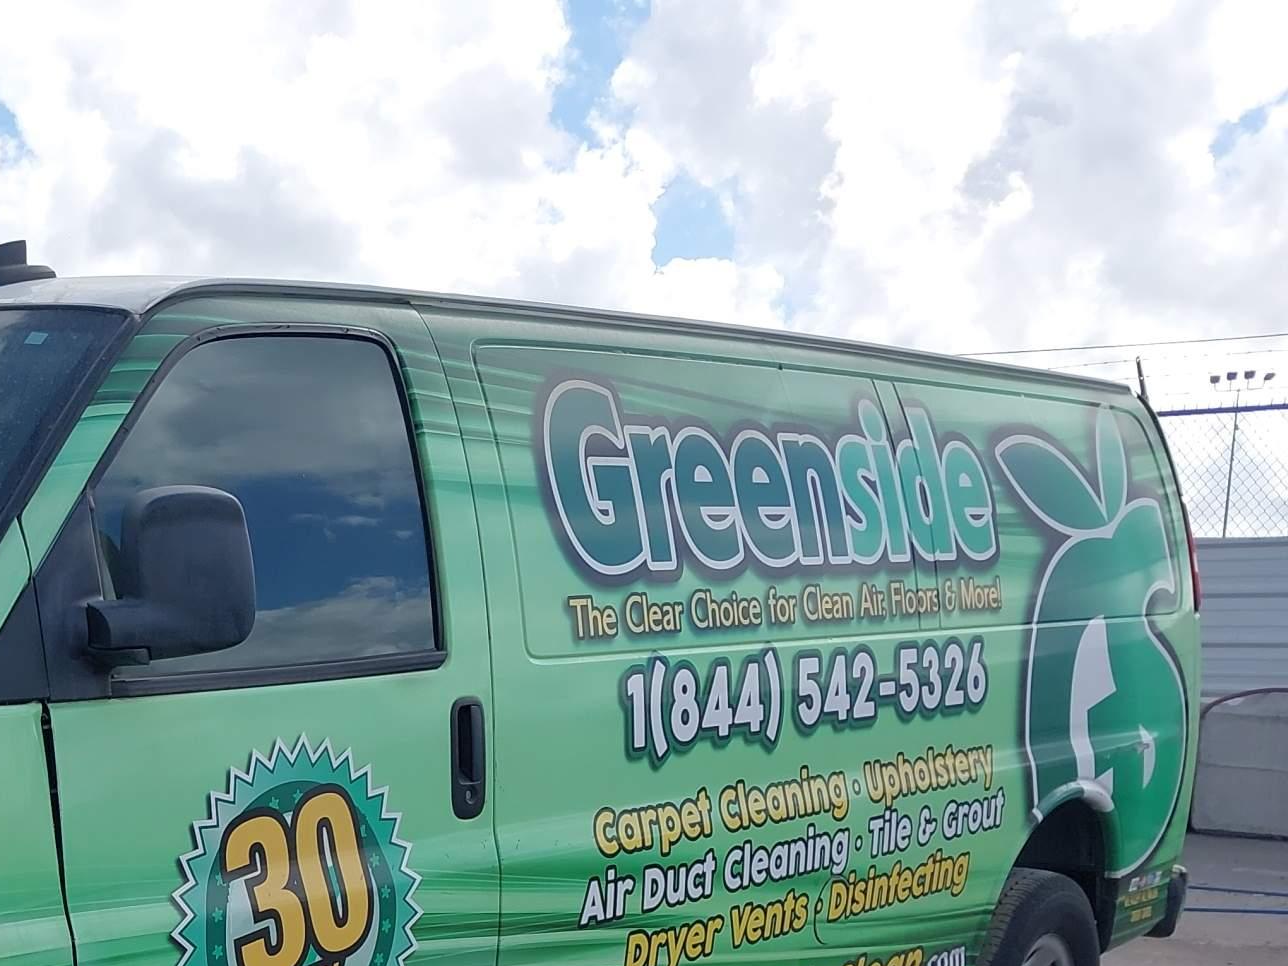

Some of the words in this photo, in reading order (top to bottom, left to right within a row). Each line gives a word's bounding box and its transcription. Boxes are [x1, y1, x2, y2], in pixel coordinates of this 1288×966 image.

[544, 378, 997, 576] Greenside
[569, 597, 618, 638] The
[625, 592, 684, 634] Clear
[691, 589, 762, 629] Choice
[768, 585, 797, 624] for
[803, 584, 854, 621] Clean
[890, 580, 940, 617] Floors
[945, 578, 957, 611] &
[960, 576, 1003, 610] More!
[626, 649, 782, 758] 1(844)
[797, 639, 988, 729] 542-5326
[579, 866, 636, 928] Air
[642, 849, 715, 913] Duct
[723, 823, 850, 892] Cleaning
[868, 807, 913, 858] Tile
[917, 805, 937, 846] &
[942, 787, 1005, 840] Grout
[594, 787, 712, 857] Carpet
[720, 765, 849, 821] Cleaning
[864, 744, 994, 808] Upholstery
[730, 888, 810, 948] Vents
[827, 848, 970, 923] Disinfecting
